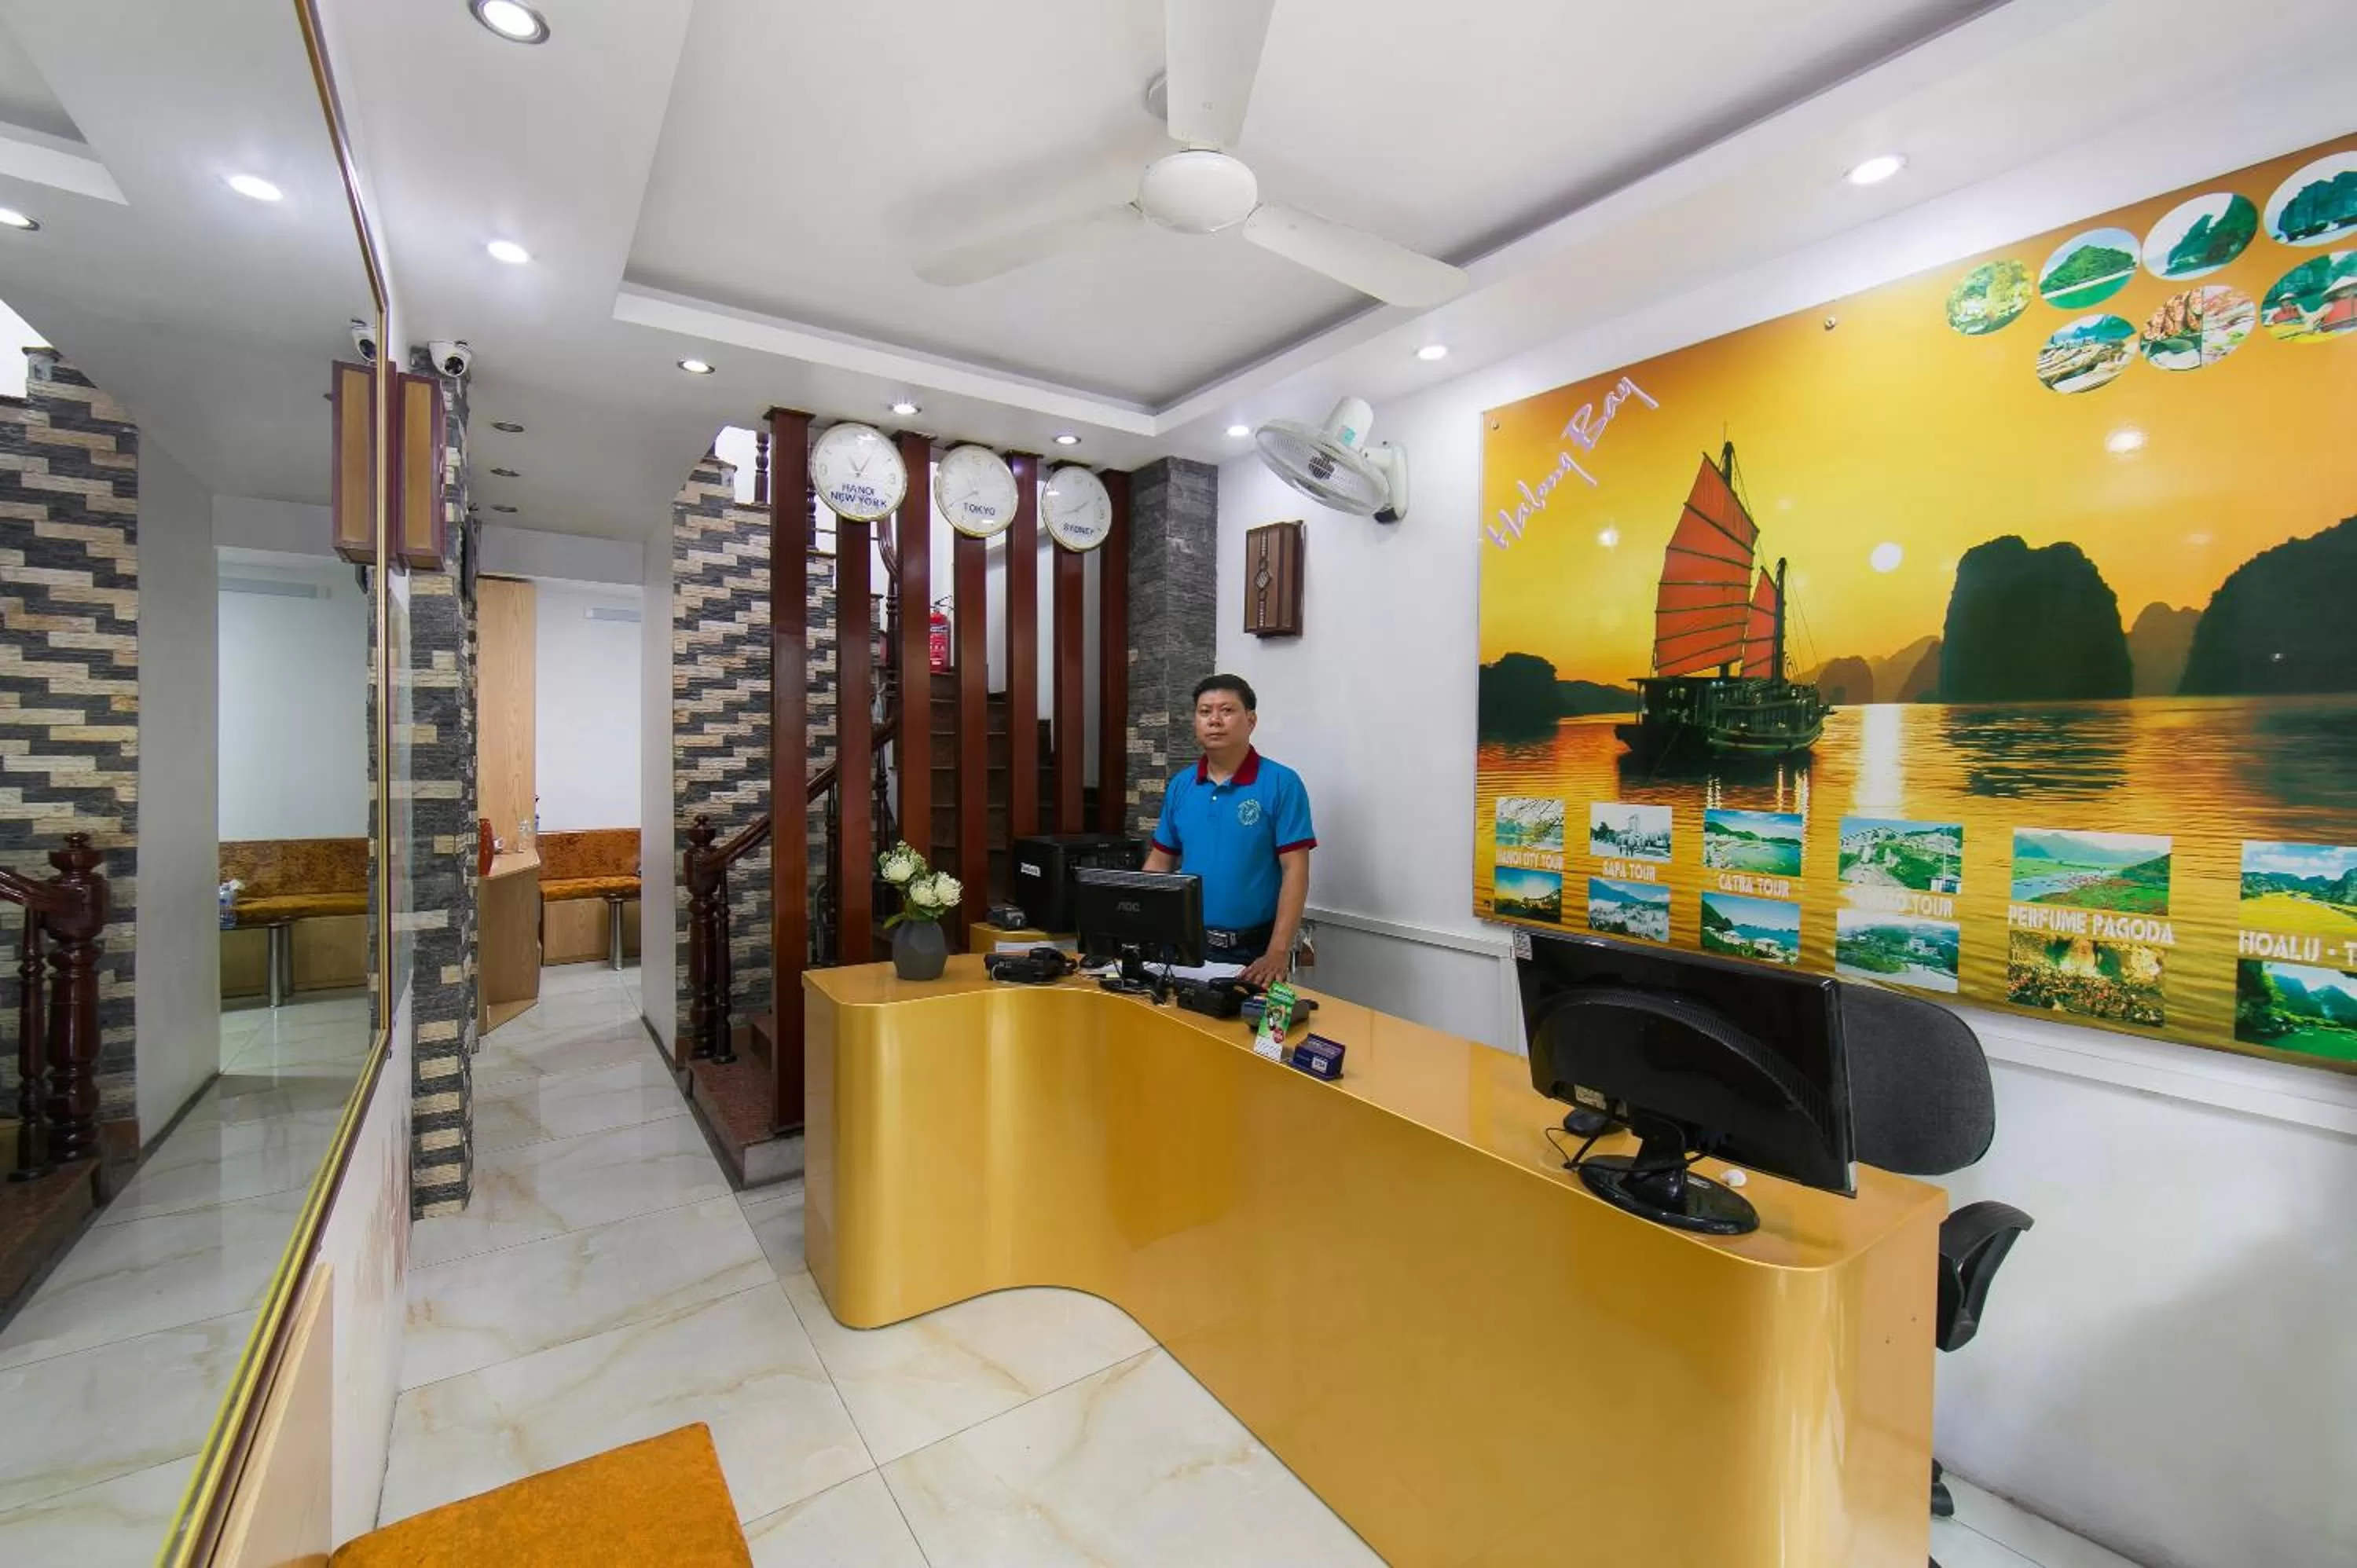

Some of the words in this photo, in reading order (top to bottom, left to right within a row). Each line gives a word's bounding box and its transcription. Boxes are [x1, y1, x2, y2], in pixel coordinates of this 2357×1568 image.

[1561, 376, 1659, 453] Bay
[830, 491, 855, 503] NEW
[858, 495, 886, 508] YORK
[841, 483, 874, 496] HANOI
[963, 503, 996, 516] TOKYO
[1063, 522, 1094, 536] SYDNEY
[1603, 860, 1626, 878] SAPA
[1629, 863, 1655, 882] TOUR
[1759, 877, 1790, 898] TOUR
[1910, 894, 1953, 918] TOUR
[2008, 904, 2088, 934] PERFUME
[2092, 914, 2176, 945] PAGODA
[2239, 929, 2321, 962] HOALU
